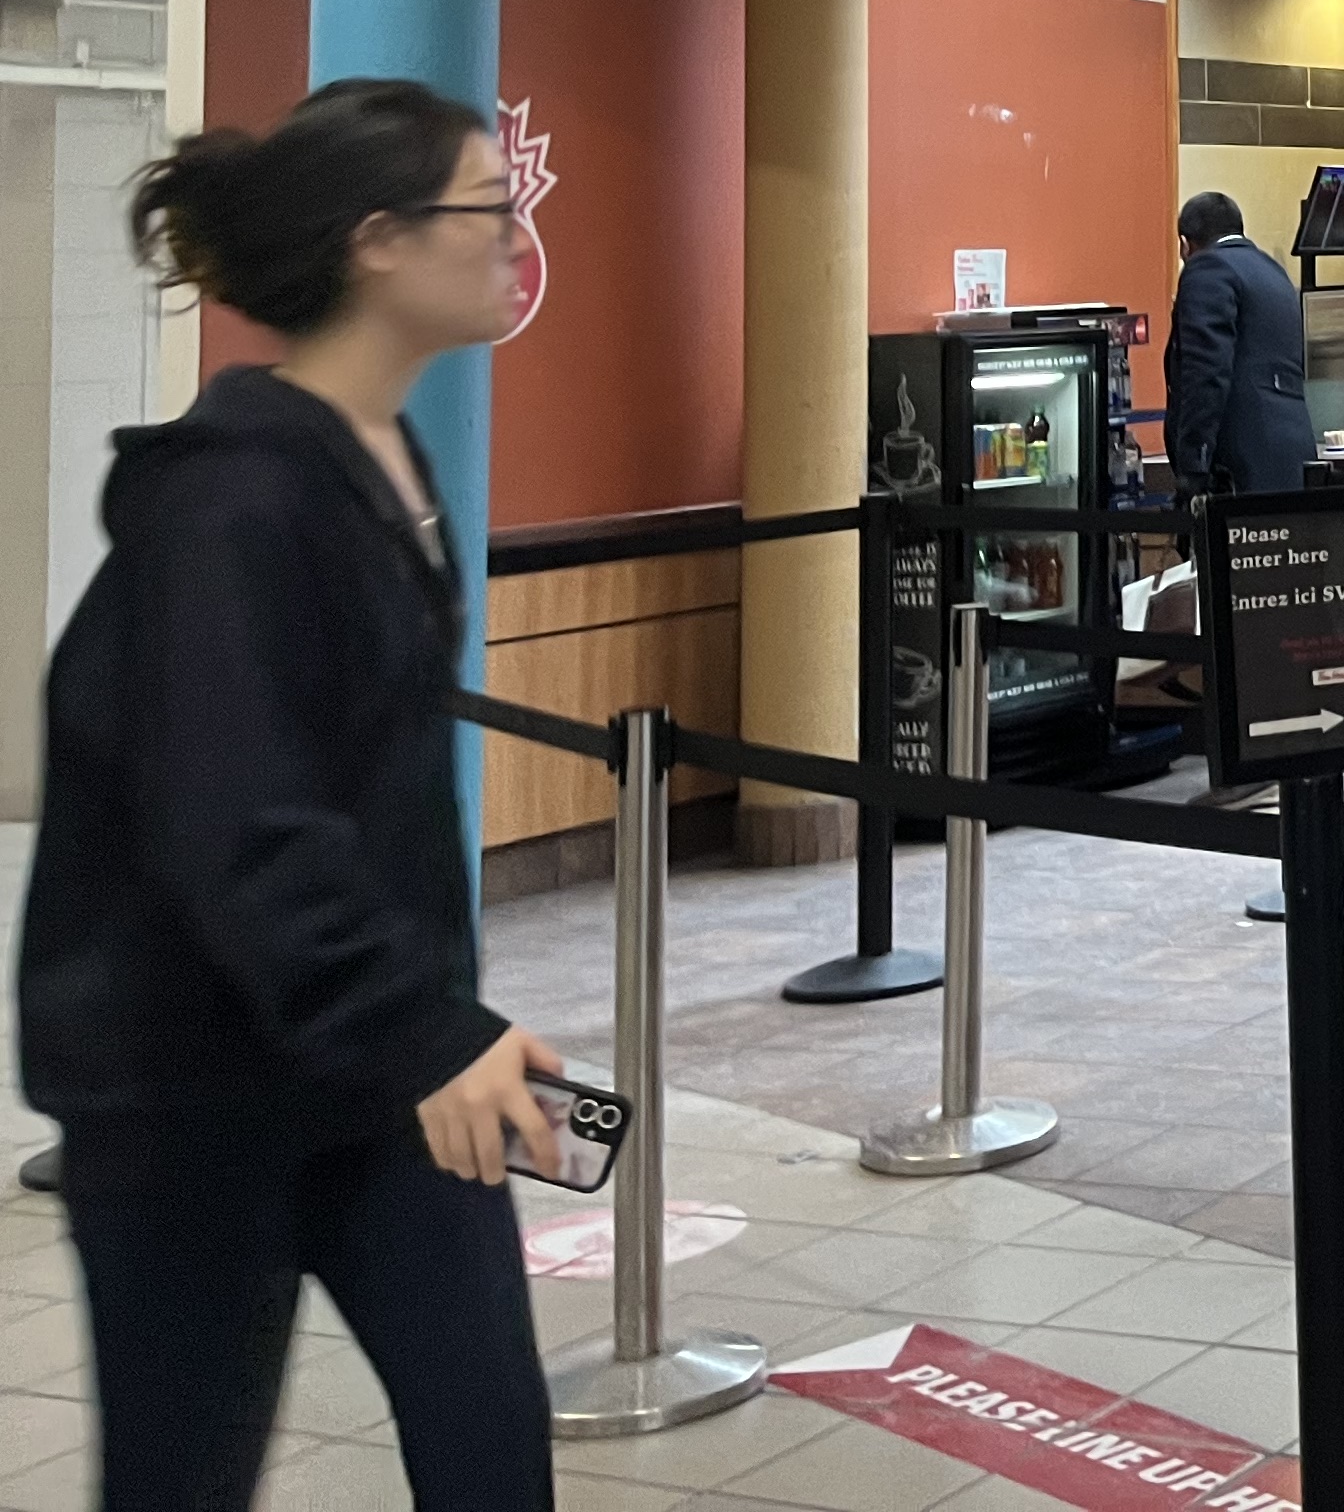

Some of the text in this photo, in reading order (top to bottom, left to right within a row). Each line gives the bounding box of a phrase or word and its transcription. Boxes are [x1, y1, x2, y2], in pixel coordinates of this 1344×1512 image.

[1228, 527, 1290, 544] Please
[1231, 548, 1329, 570] enter here
[1231, 594, 1289, 611] Entrez
[1295, 586, 1316, 605] ici
[885, 1364, 1061, 1432] PLEASE
[1031, 1421, 1160, 1471] LINE
[1138, 1457, 1226, 1494] UP
